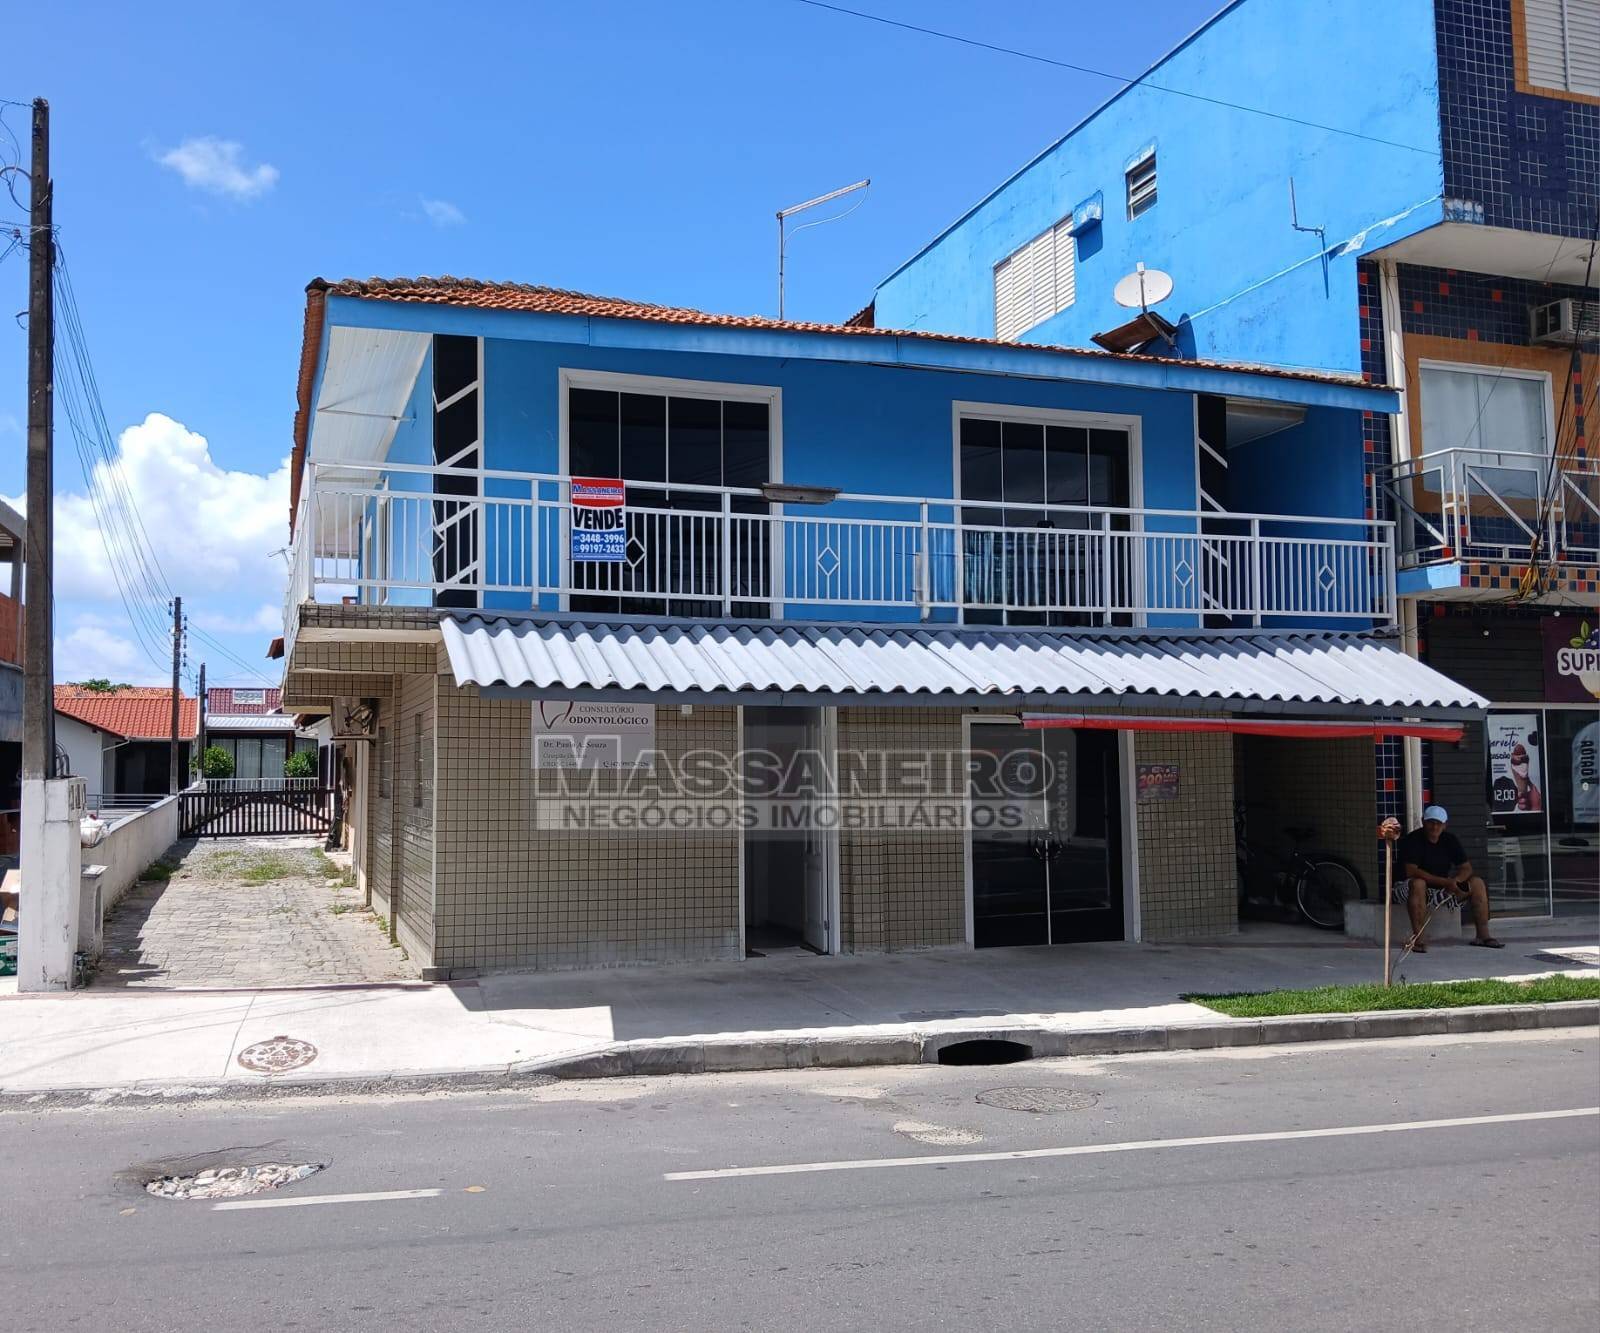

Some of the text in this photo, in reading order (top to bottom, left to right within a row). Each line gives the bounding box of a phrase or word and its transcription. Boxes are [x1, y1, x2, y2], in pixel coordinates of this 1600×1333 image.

[573, 506, 624, 530] VENDE
[580, 533, 625, 543] 3448-3996
[580, 544, 625, 553] 99197-2433
[579, 704, 634, 714] CONSULTÓRIO
[569, 715, 649, 725] ODONTOLÓGICO
[1494, 789, 1515, 802] 12,00
